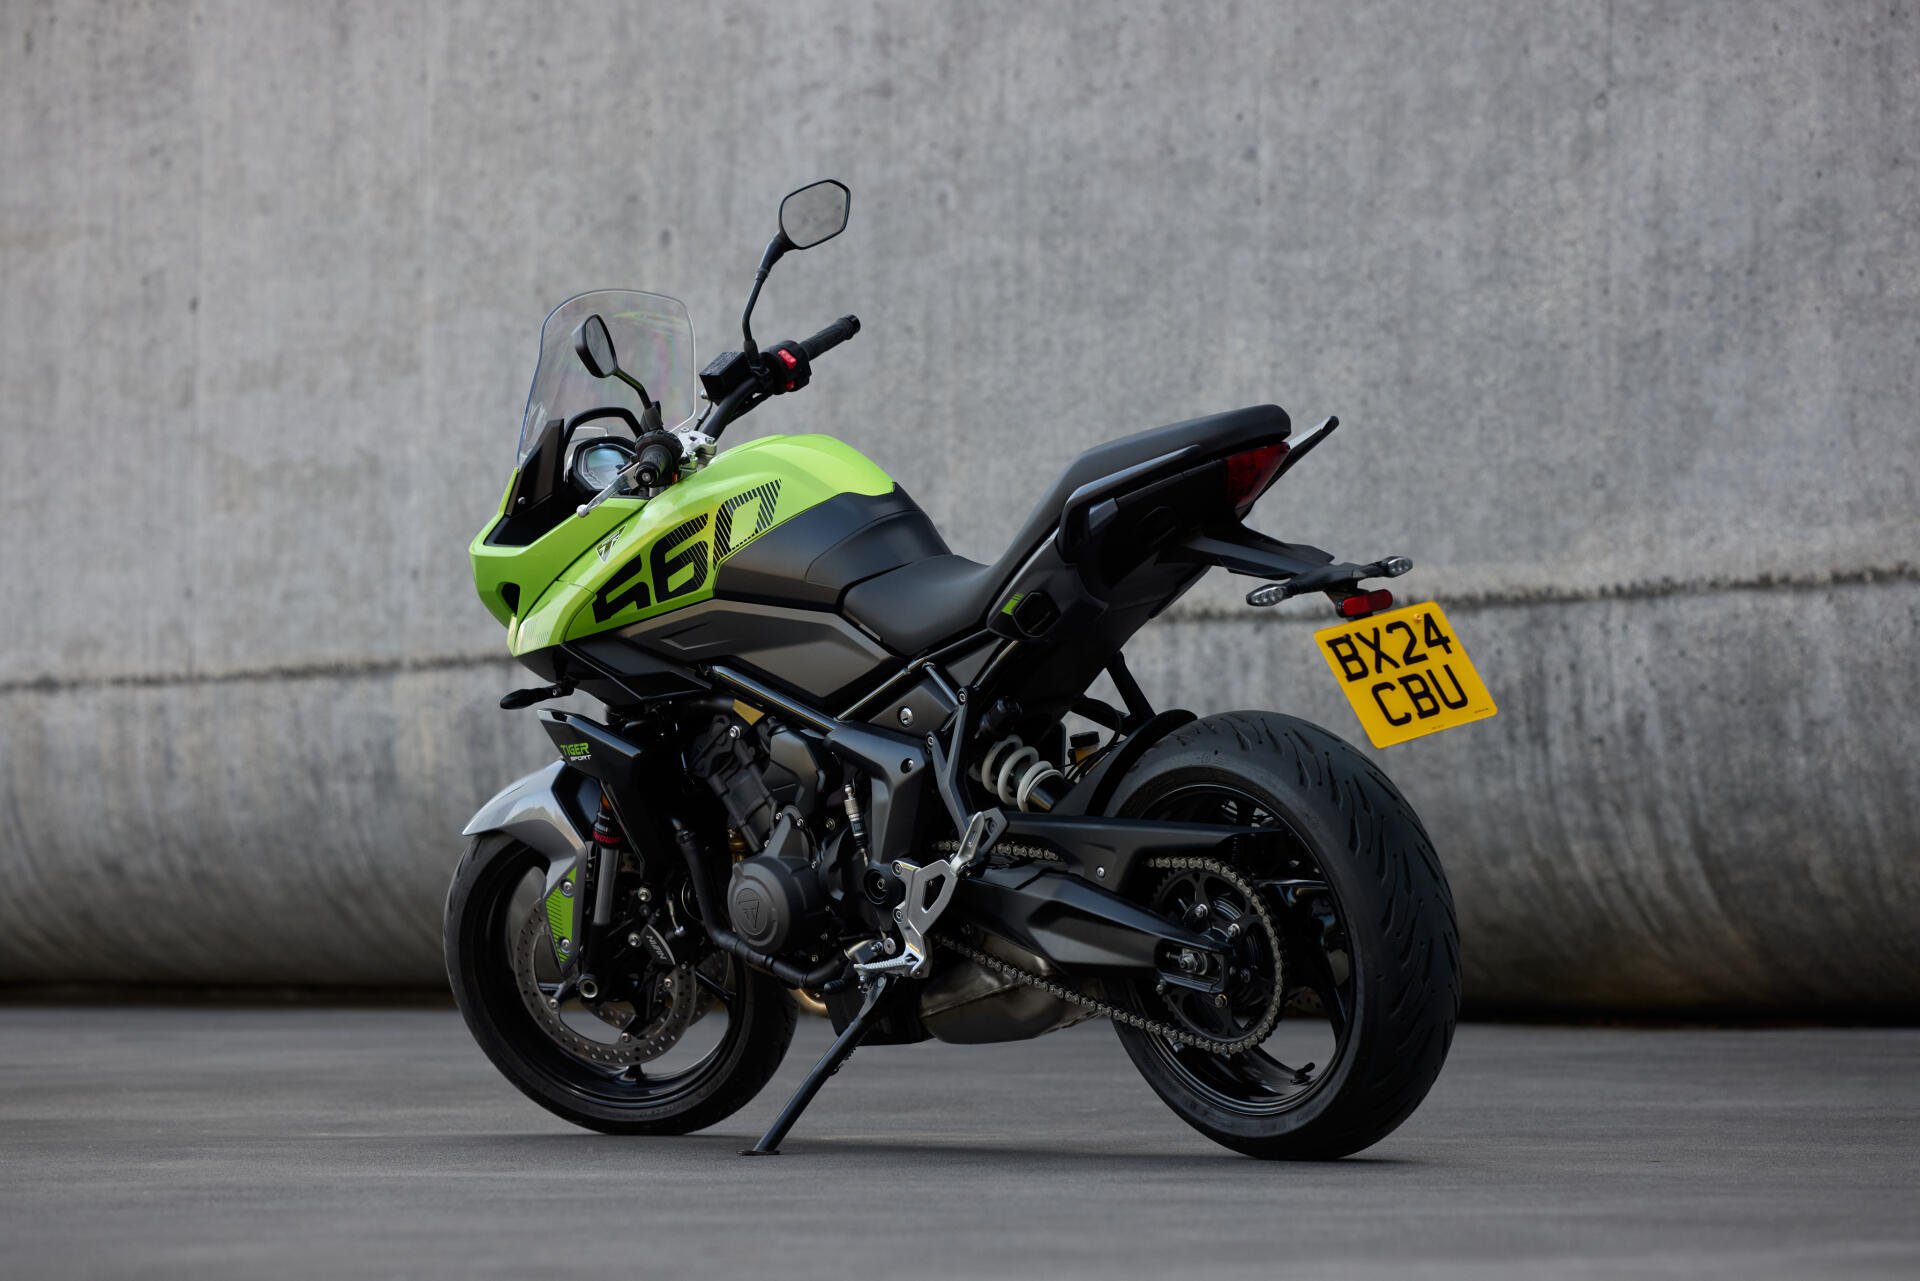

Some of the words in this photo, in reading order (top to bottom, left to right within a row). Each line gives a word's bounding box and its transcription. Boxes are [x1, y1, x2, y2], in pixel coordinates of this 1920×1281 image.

[1326, 613, 1452, 682] BX24
[1371, 664, 1468, 726] CBU
[560, 742, 590, 756] TIGER
